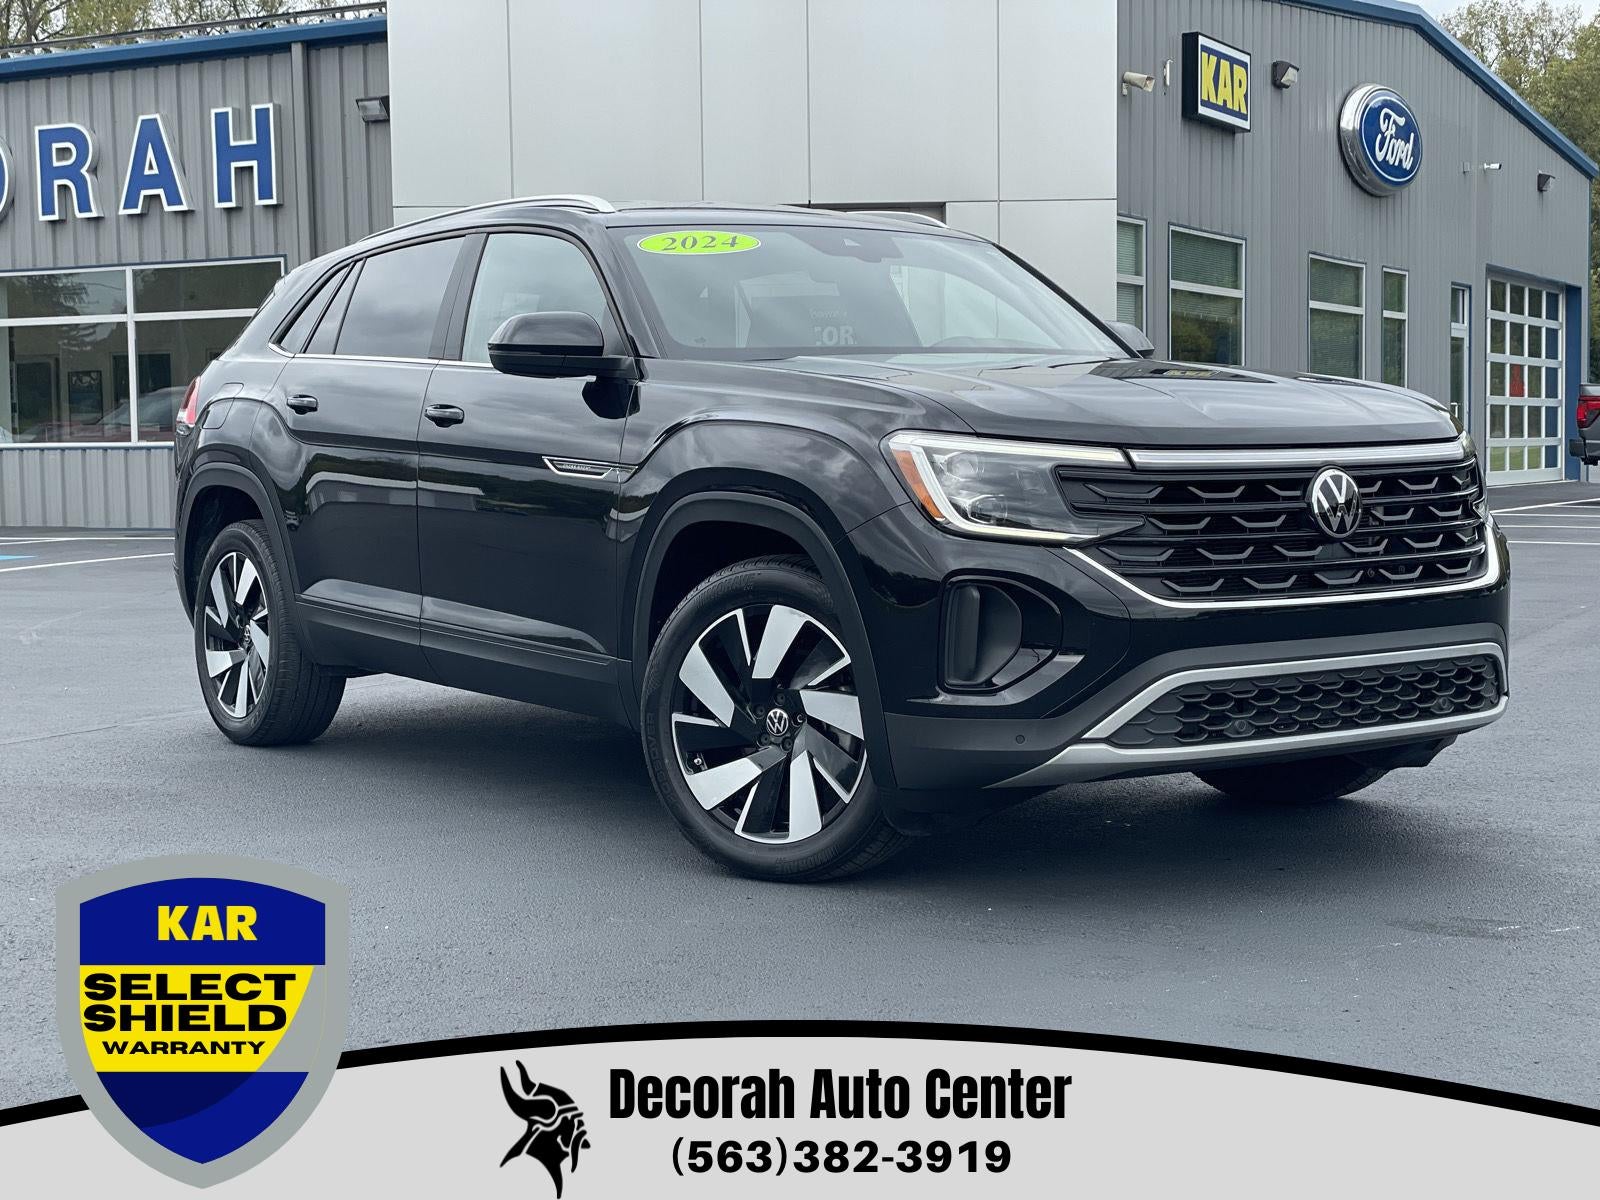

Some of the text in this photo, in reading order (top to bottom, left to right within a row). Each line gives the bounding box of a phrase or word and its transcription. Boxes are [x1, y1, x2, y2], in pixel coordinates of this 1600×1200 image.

[1201, 51, 1248, 115] KAR
[0, 103, 279, 221] RAH
[1375, 107, 1415, 170] Ford
[661, 234, 740, 252] 2024
